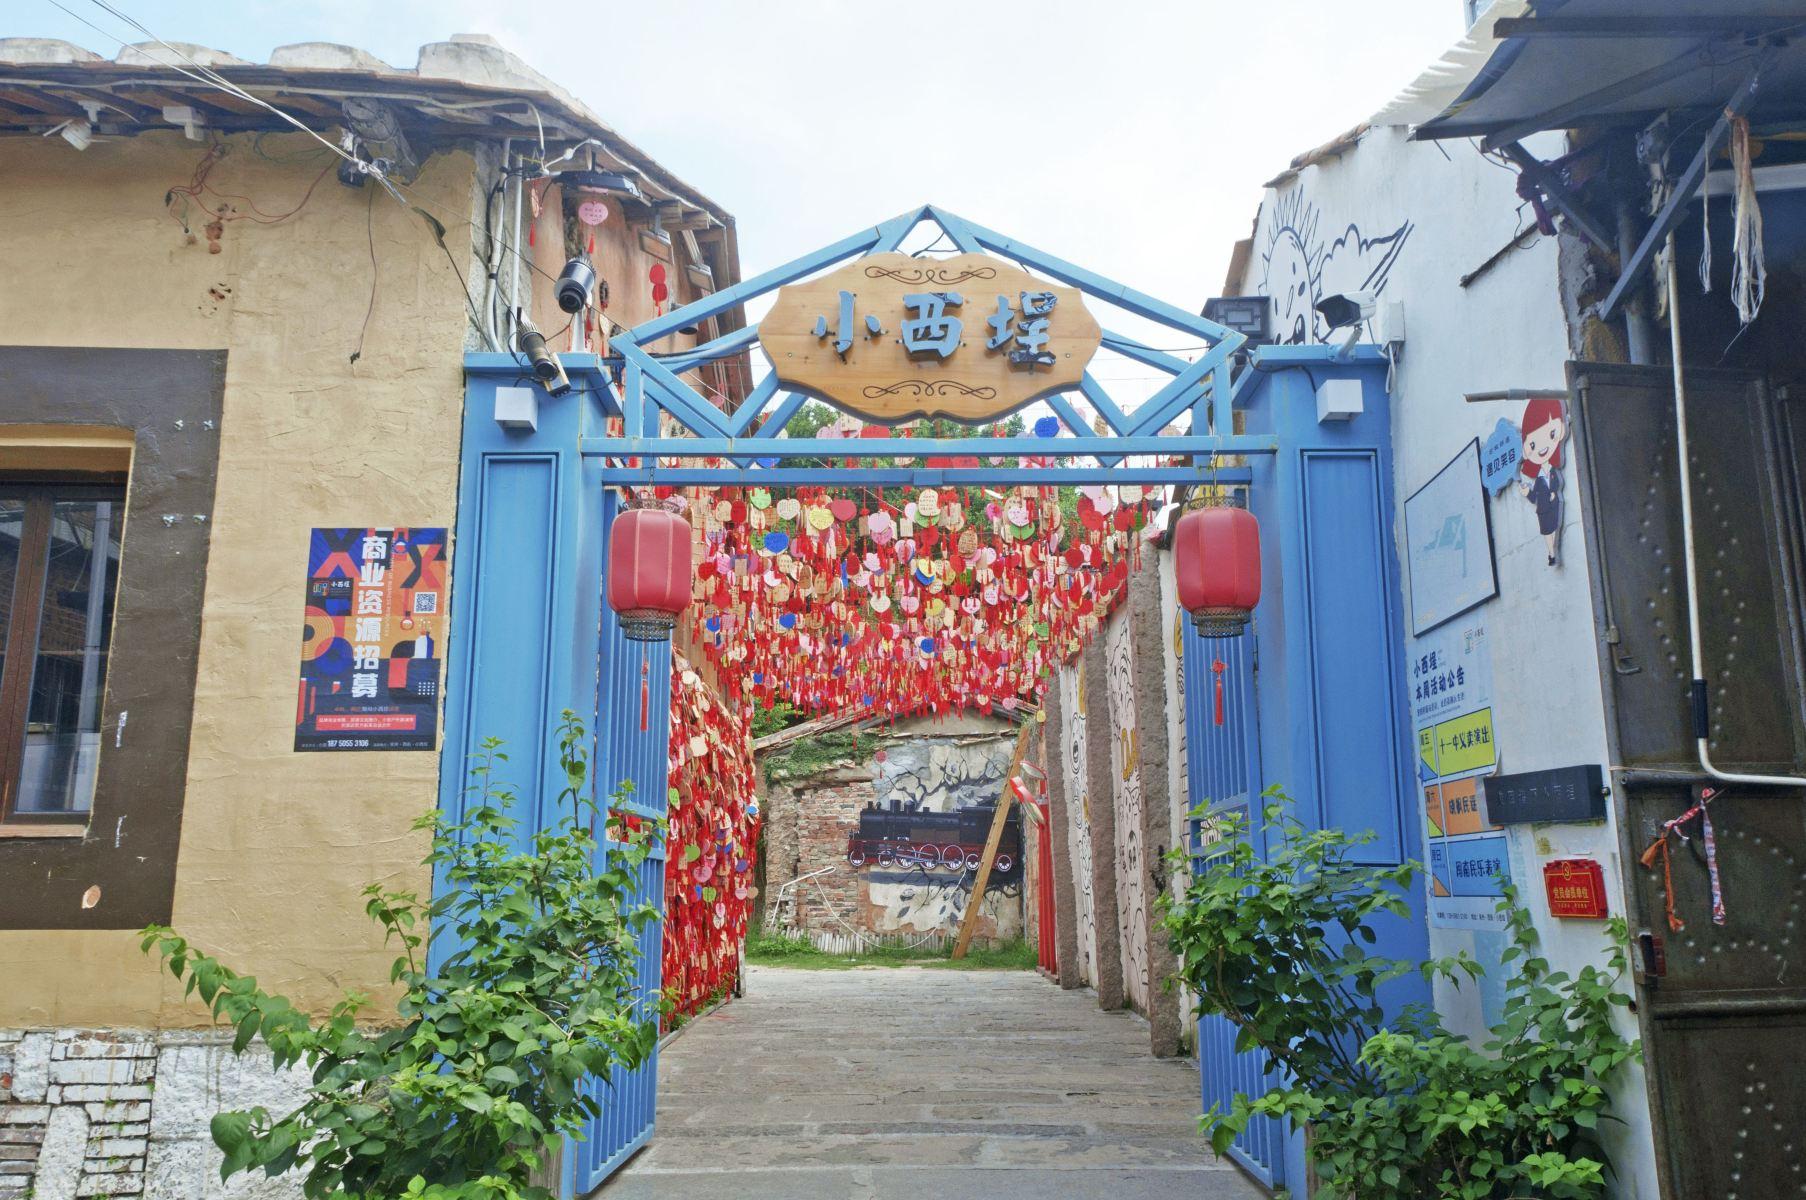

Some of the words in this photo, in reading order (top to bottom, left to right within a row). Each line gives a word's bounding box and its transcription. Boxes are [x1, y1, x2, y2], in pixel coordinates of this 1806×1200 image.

[812, 290, 1058, 367] 小西埕
[351, 536, 388, 698] 商业资源招募
[1413, 650, 1438, 678] 小西埕
